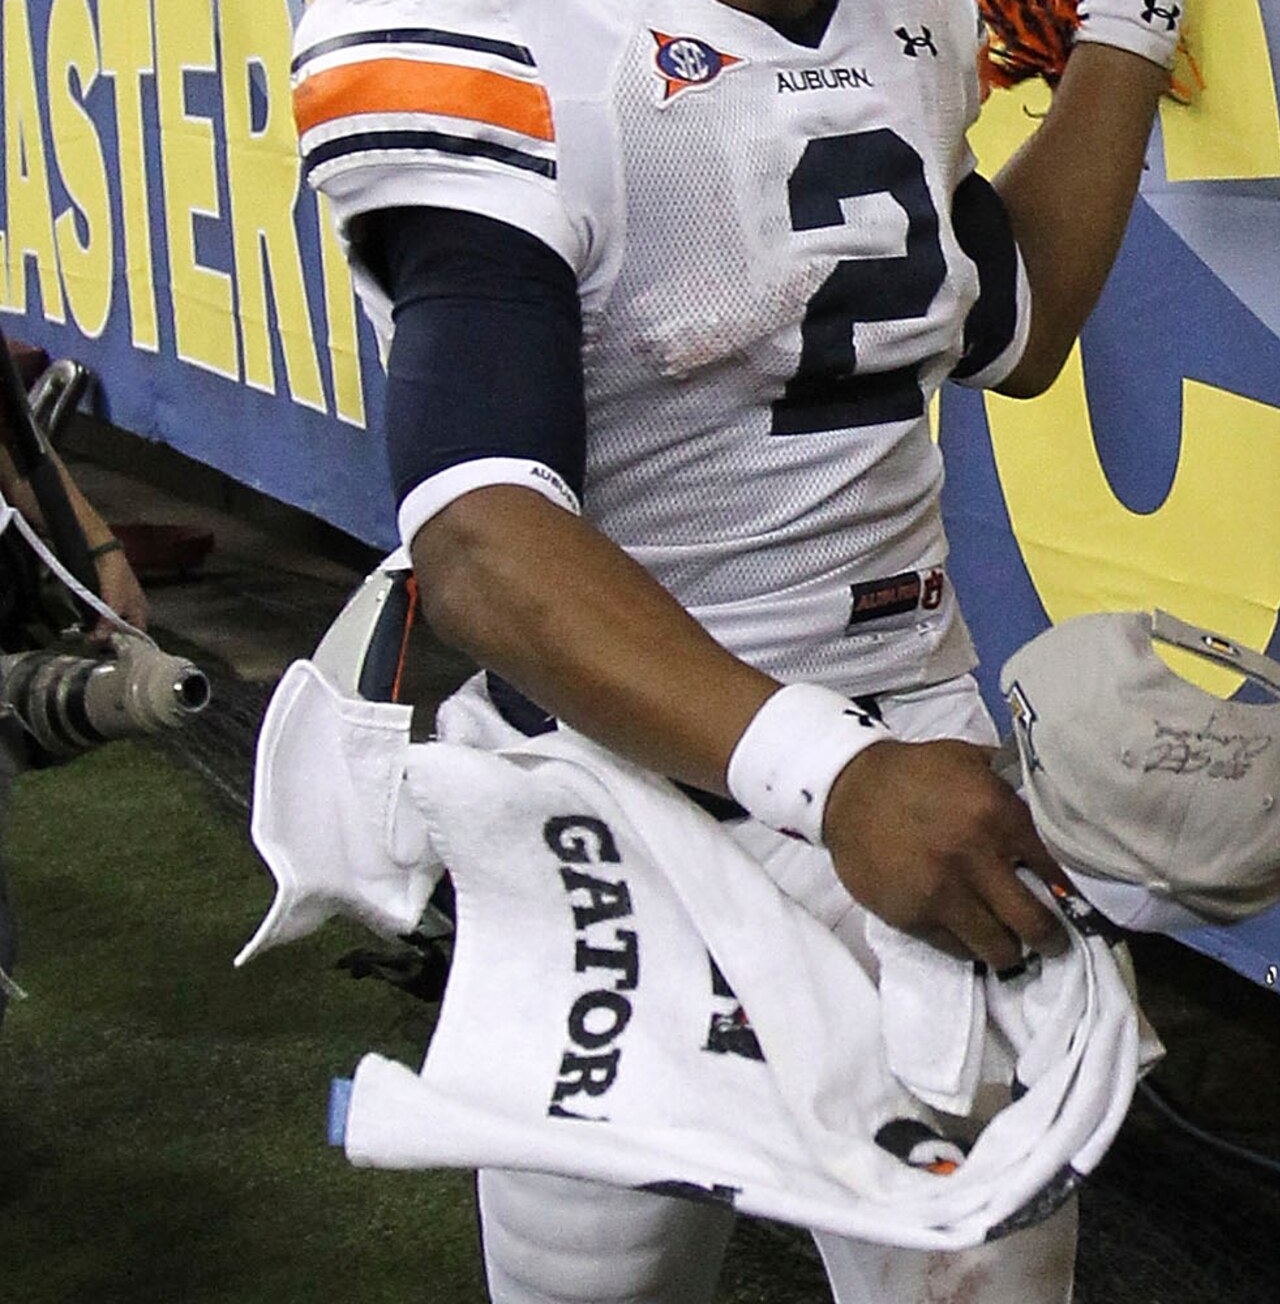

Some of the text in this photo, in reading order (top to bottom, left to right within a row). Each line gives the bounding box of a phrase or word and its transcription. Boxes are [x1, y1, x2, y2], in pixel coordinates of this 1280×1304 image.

[777, 68, 874, 94] AUBURN
[769, 127, 949, 436] 2
[543, 814, 639, 1122] GATOR
